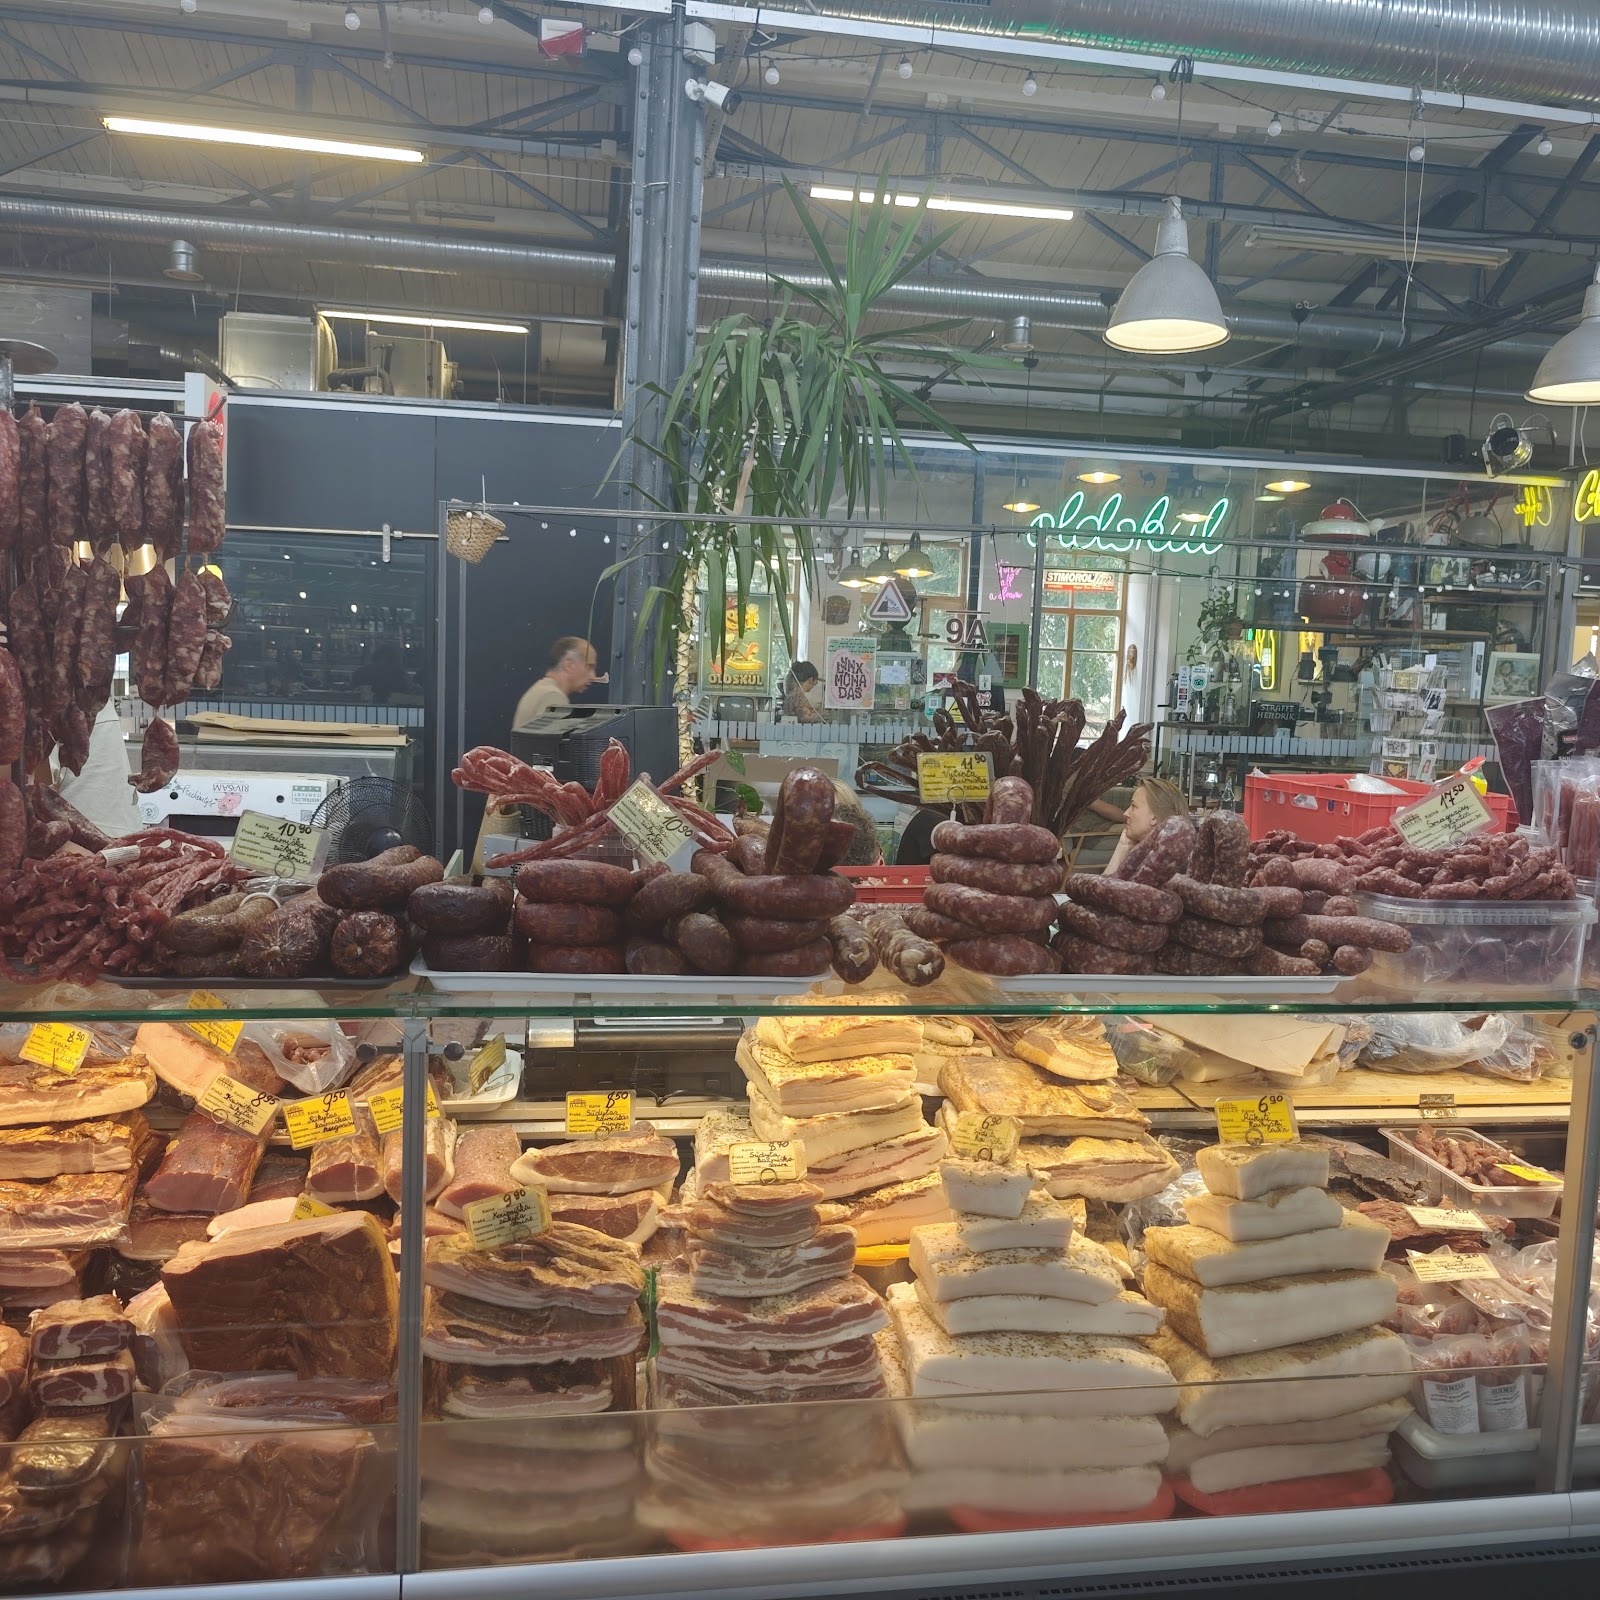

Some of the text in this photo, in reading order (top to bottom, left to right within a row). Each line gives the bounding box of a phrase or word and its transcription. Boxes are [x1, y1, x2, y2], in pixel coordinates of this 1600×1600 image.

[1046, 572, 1096, 583] STIMOROL
[946, 618, 989, 645] 9A
[835, 672, 867, 688] MONA
[838, 687, 862, 700] DAS
[213, 784, 249, 792] RIVASAM
